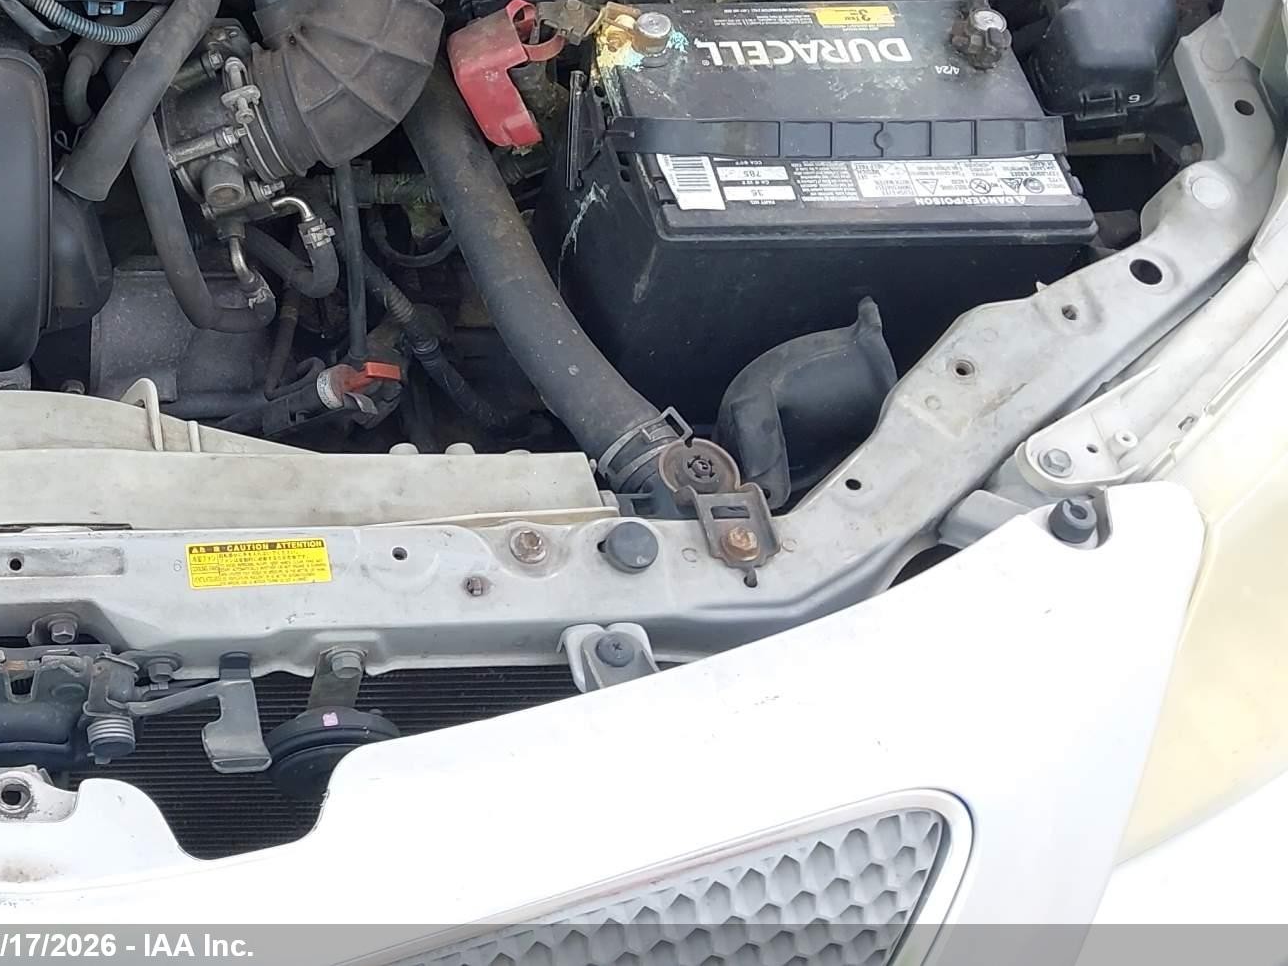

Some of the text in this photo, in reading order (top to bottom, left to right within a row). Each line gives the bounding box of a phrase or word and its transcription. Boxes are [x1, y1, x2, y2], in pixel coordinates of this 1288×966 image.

[694, 38, 912, 66] DURACELL
[914, 196, 1013, 206] DANGER/POISON
[227, 543, 269, 552] CAUTION
[276, 540, 322, 550] ATTENTION
